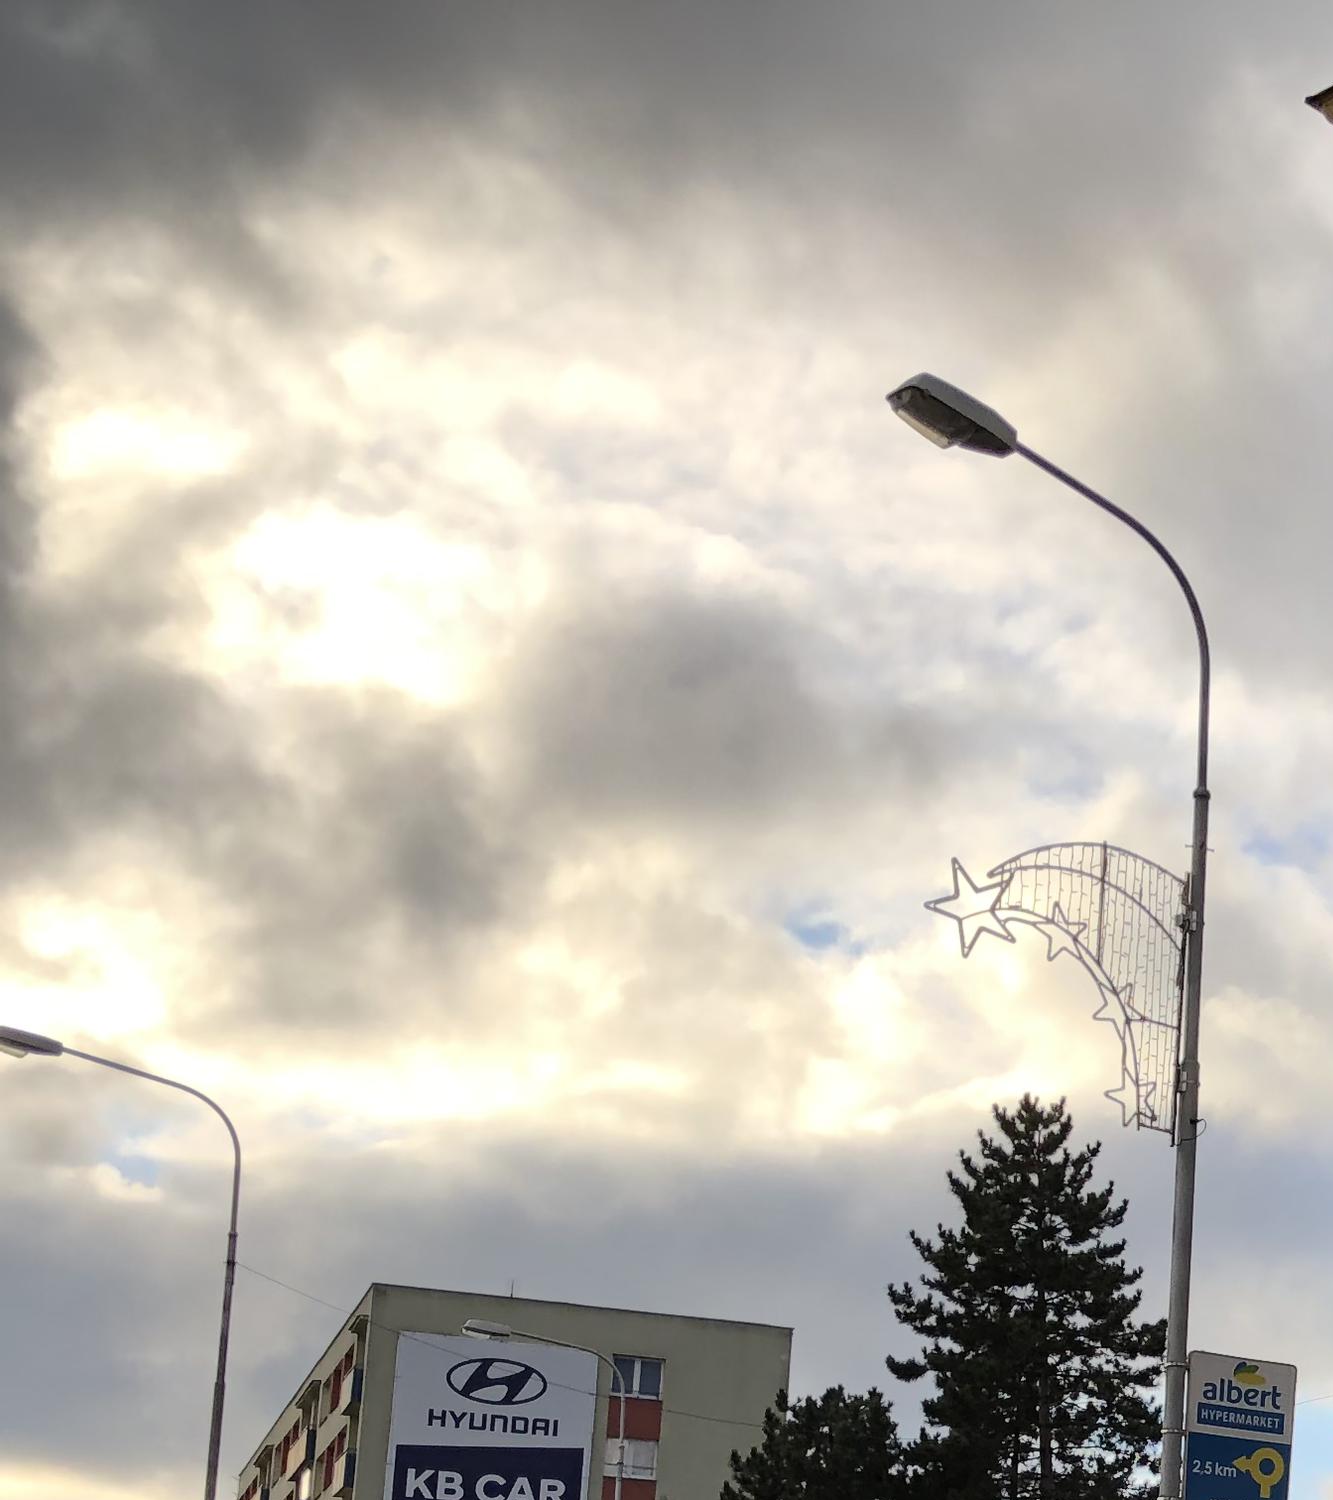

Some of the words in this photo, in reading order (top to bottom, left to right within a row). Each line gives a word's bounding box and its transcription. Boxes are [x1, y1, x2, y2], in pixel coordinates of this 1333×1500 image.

[1202, 1378, 1282, 1410] albert
[427, 1408, 559, 1437] HYUNDAI
[1201, 1408, 1280, 1430] HYPERMARKET
[405, 1467, 464, 1500] KB
[1192, 1460, 1213, 1476] 2,5
[1215, 1461, 1237, 1478] km
